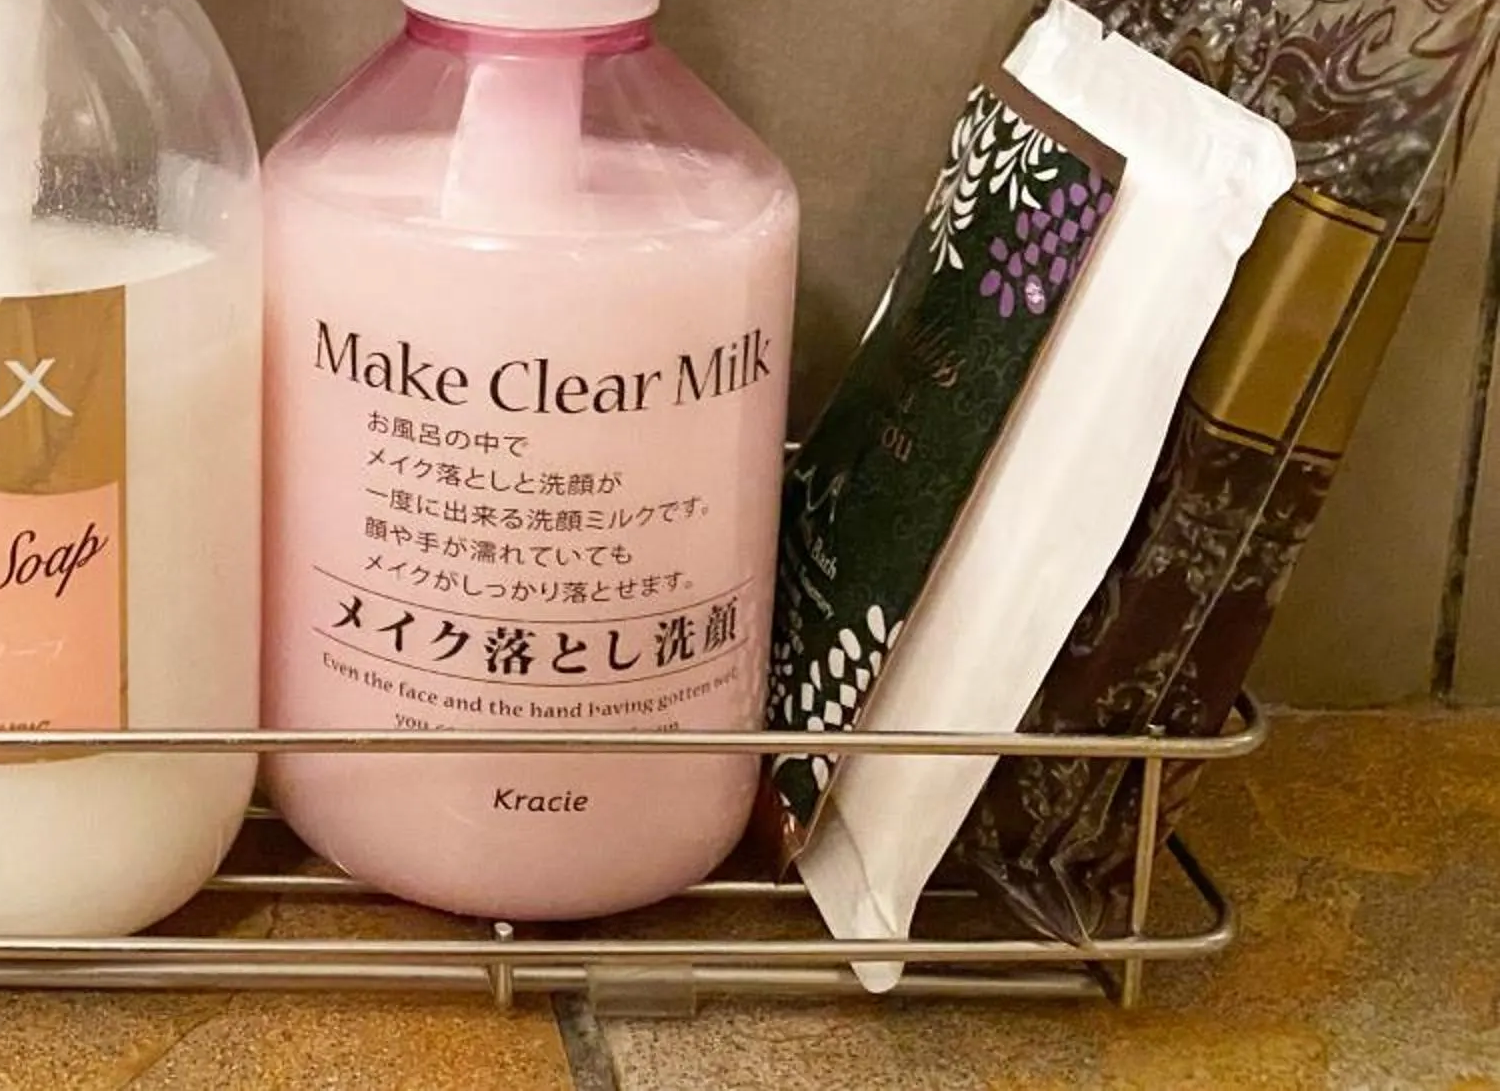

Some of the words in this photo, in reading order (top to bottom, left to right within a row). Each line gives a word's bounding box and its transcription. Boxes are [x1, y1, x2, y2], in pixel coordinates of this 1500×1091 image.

[313, 318, 469, 405] Make
[489, 357, 661, 414] Clear
[672, 328, 772, 406] Milk
[367, 410, 529, 458] お風呂の中で
[367, 447, 622, 496] メイク落としと洗顔が
[365, 487, 709, 532] 一度に出来る洗顔ミルクです。
[364, 554, 694, 604] メイクがしっかり落とせます。
[331, 595, 738, 676] メイク落とし洗顔
[323, 652, 359, 681] Even
[364, 672, 393, 694] the
[399, 682, 439, 705] face
[443, 696, 482, 713] and
[489, 700, 524, 718] the
[529, 702, 582, 718] hand
[657, 683, 712, 712] gotten
[493, 787, 589, 813] Kracie
